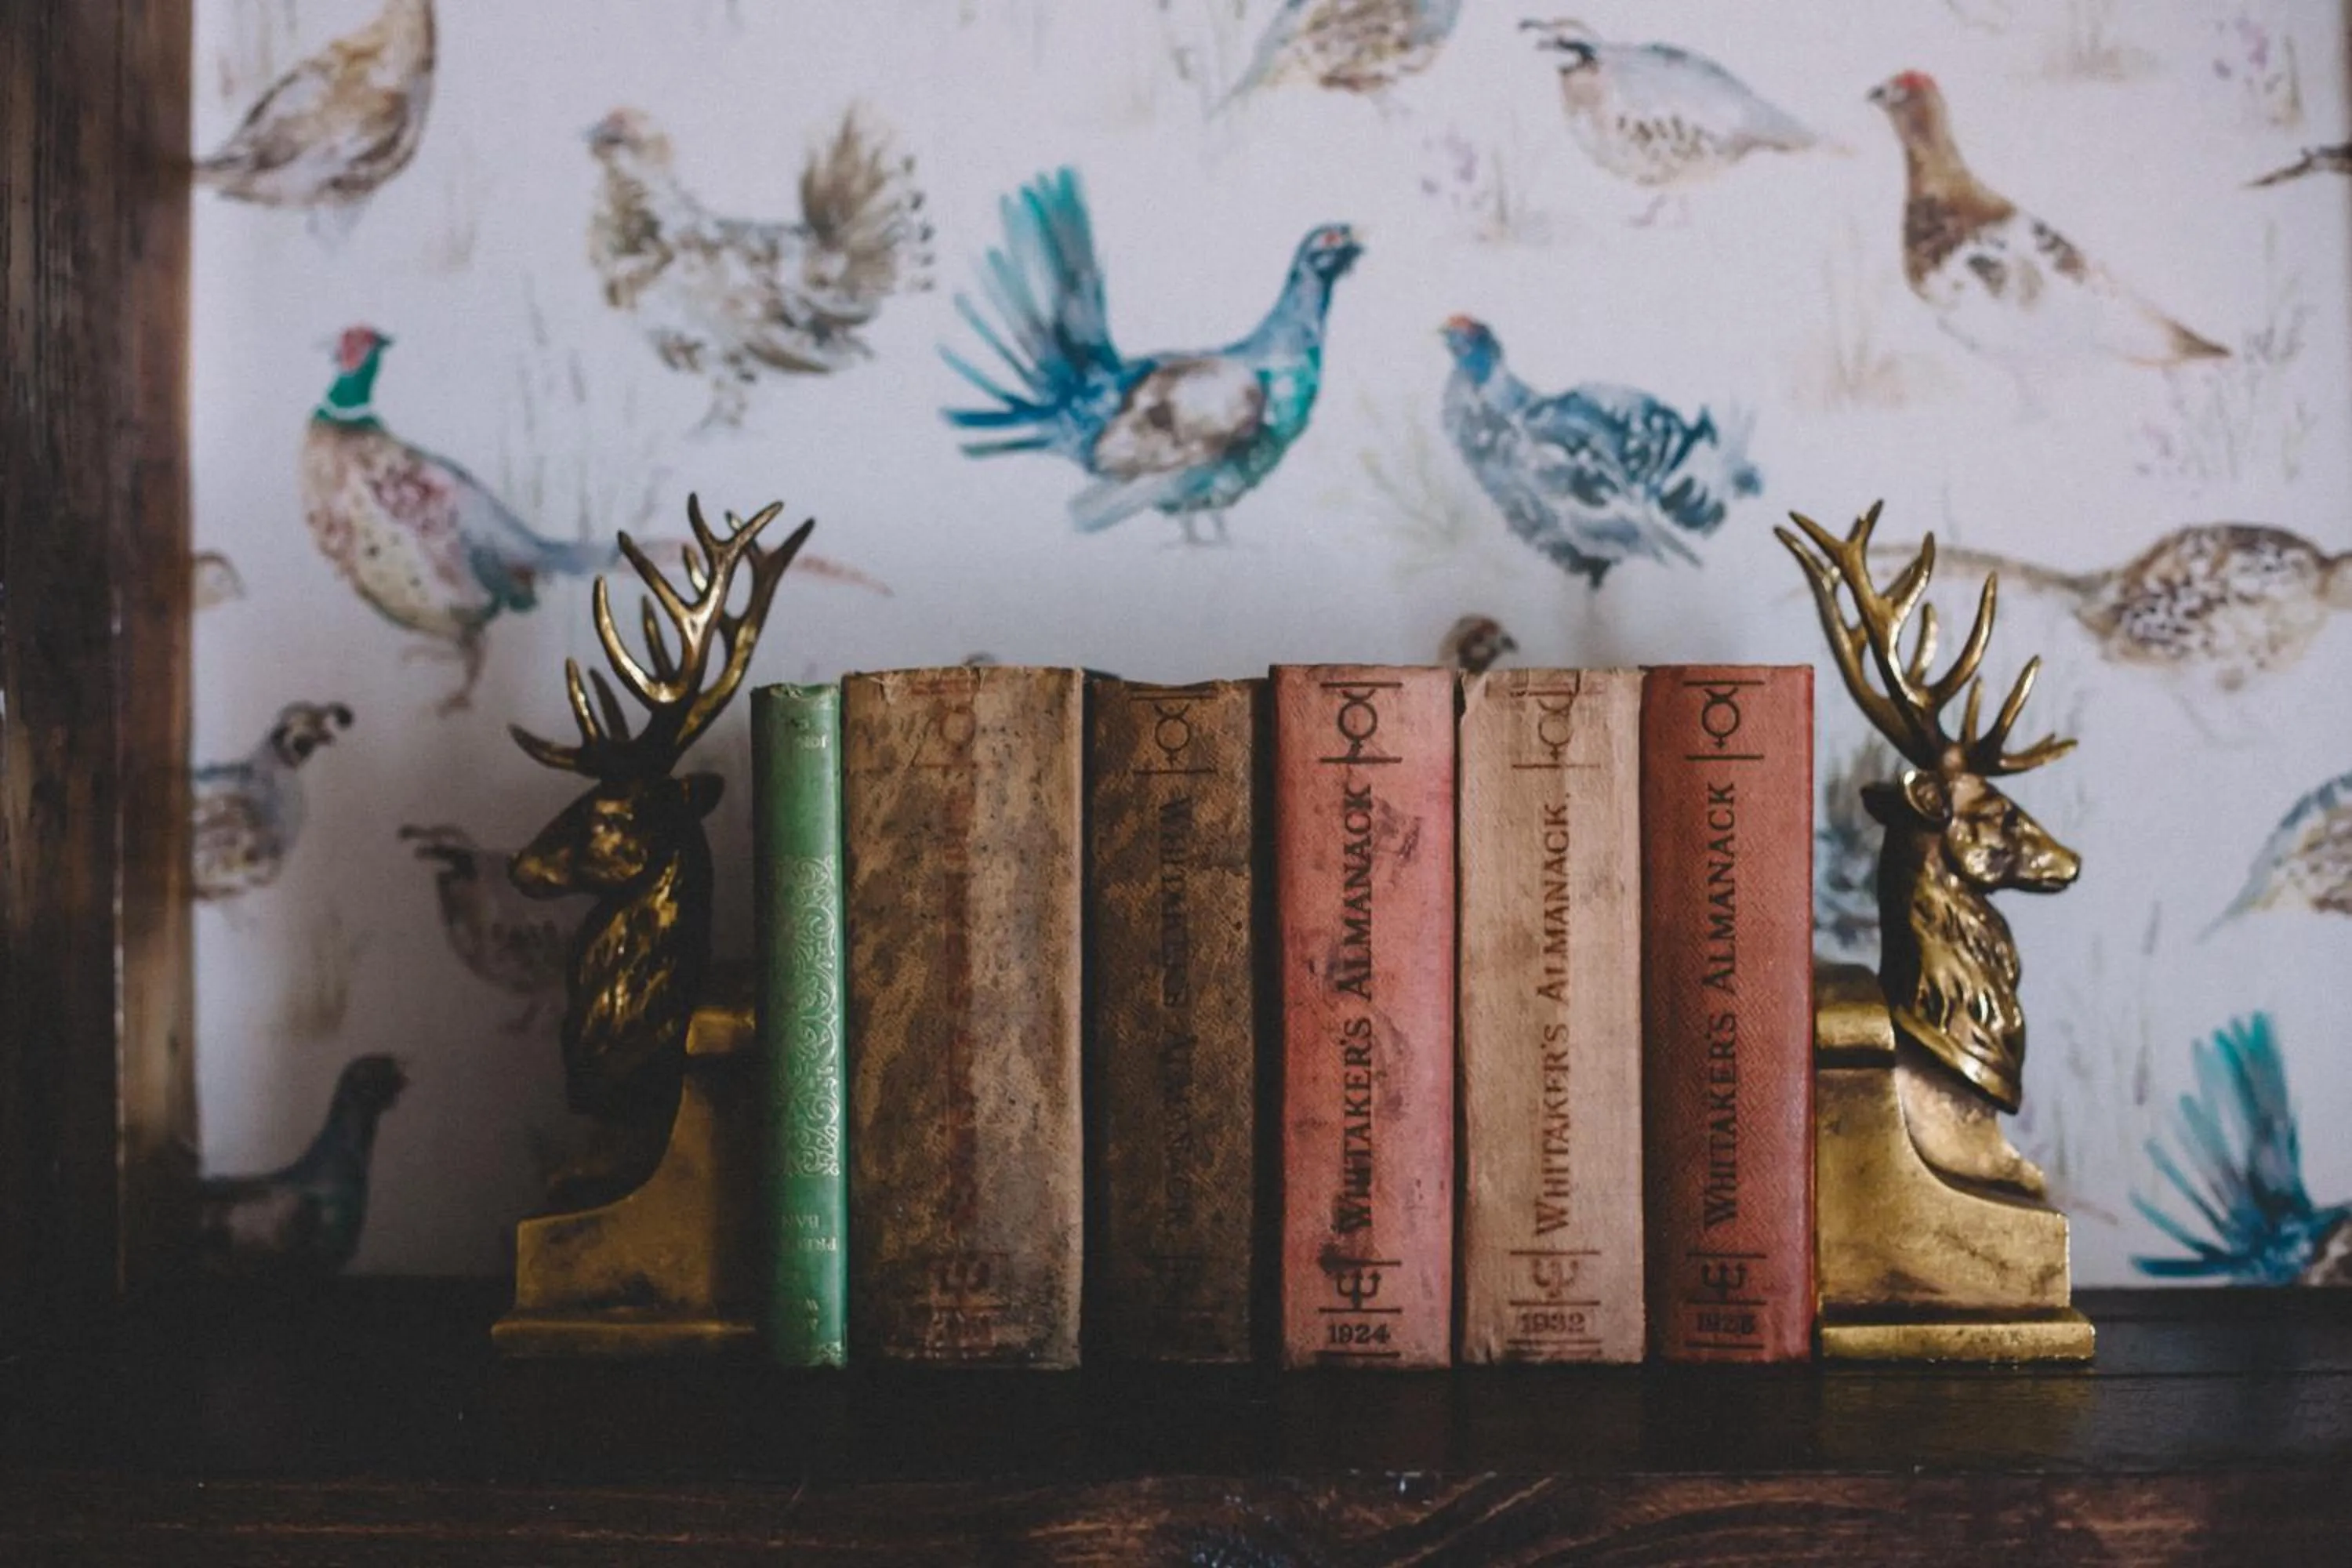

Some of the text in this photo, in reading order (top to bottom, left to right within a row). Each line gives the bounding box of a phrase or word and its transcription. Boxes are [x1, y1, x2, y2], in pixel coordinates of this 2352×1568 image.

[1335, 782, 1372, 1234] WHITAKER'S ALMANACK
[1534, 1022, 1570, 1236] WHITAKER'S
[1701, 782, 1736, 1228] WHITAKER'S ALMANACK
[1328, 1323, 1391, 1344] 1924
